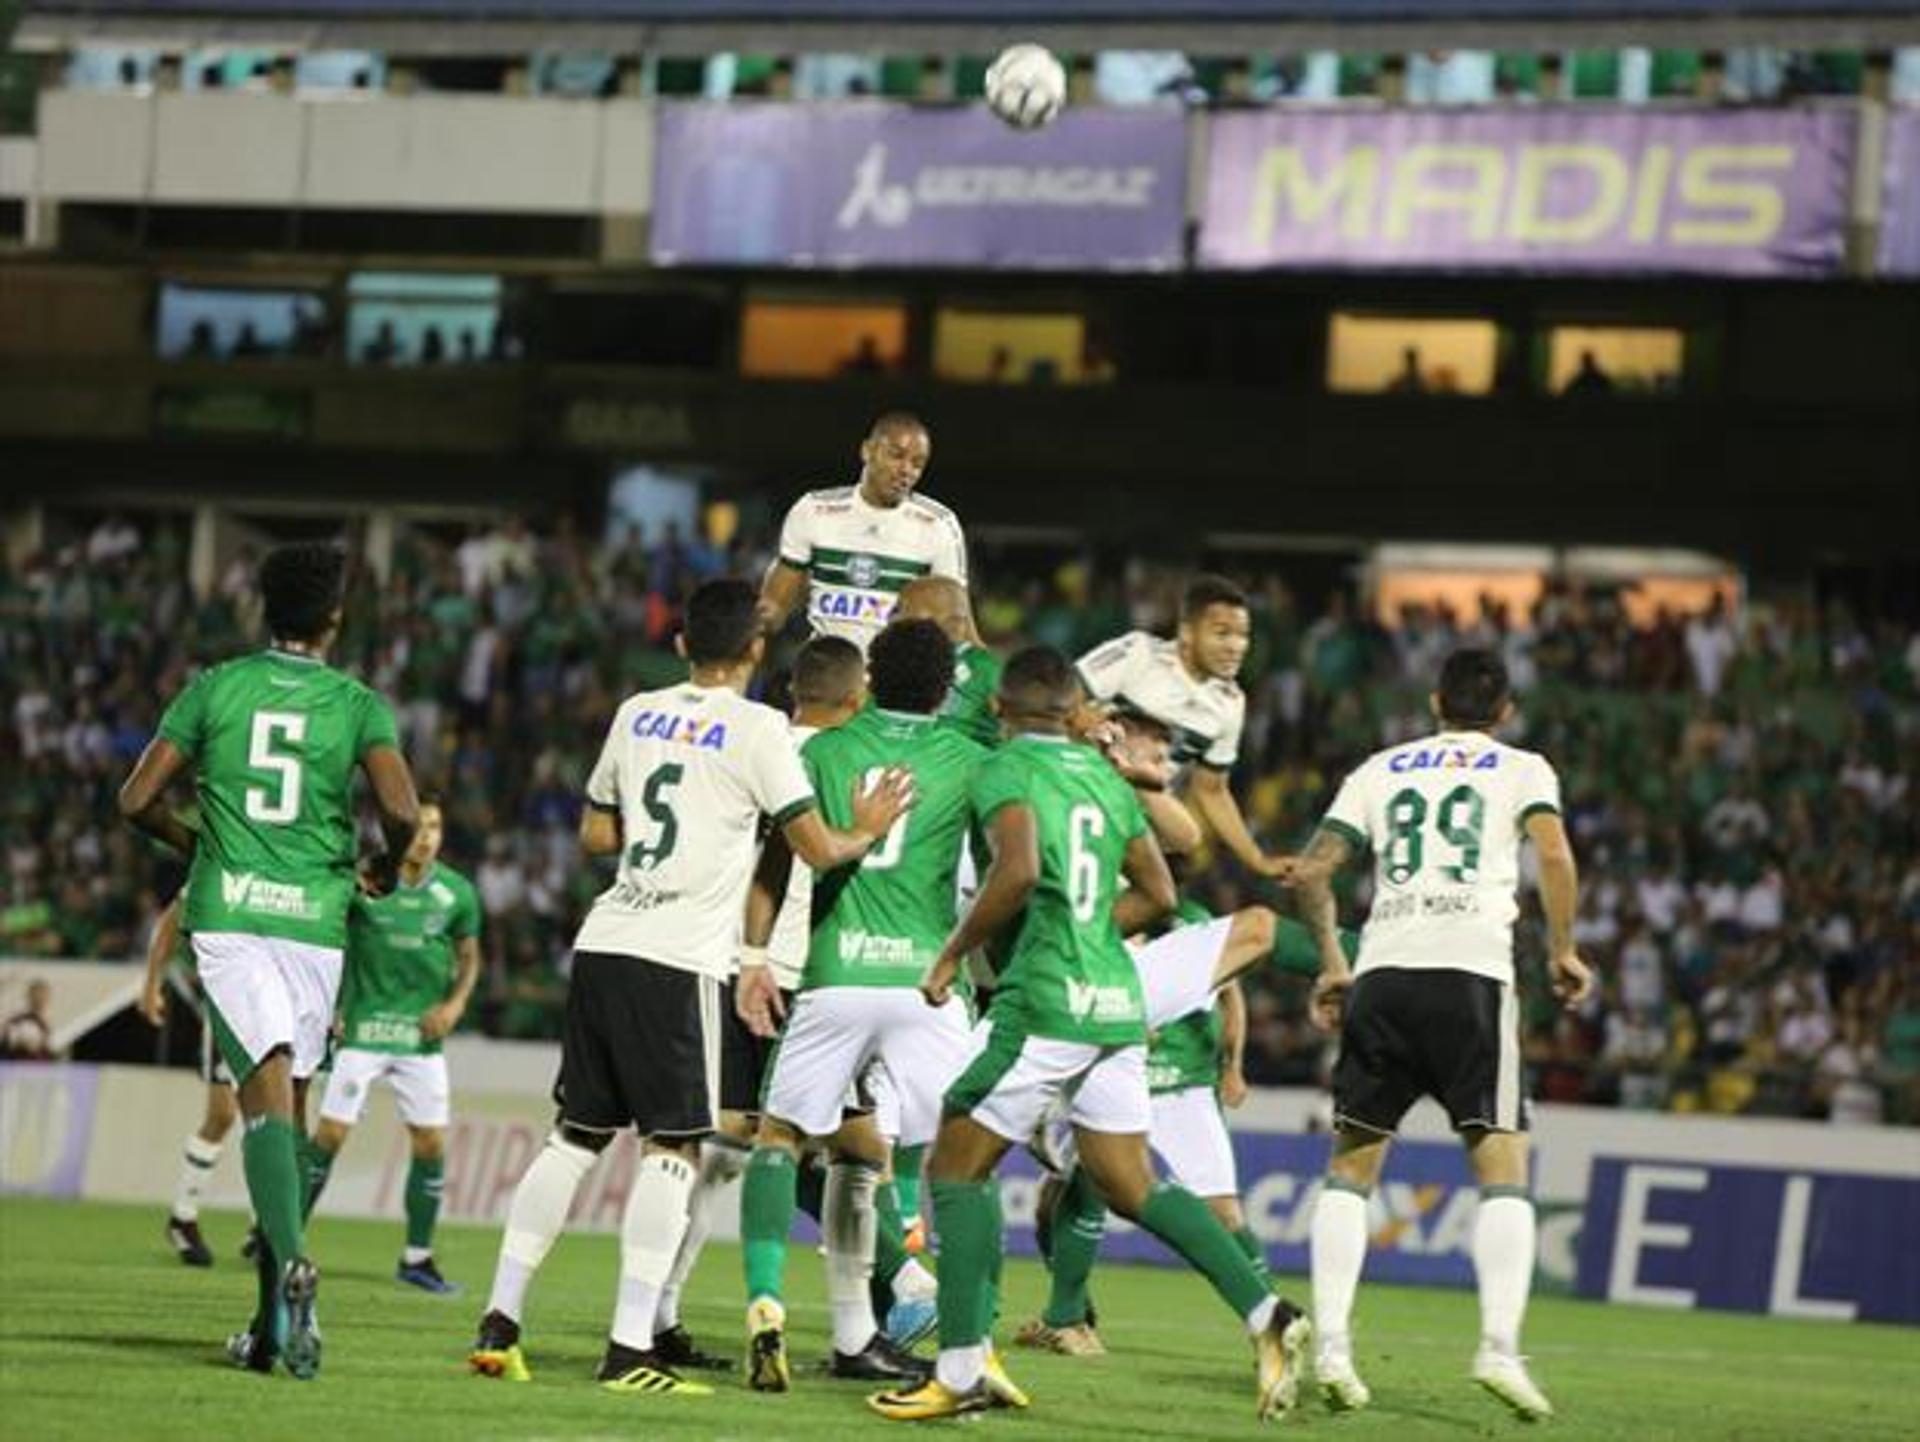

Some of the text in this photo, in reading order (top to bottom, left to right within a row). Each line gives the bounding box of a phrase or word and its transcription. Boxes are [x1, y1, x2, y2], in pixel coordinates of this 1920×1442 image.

[1248, 142, 1794, 249] MADIS
[246, 710, 306, 823] 5
[633, 711, 726, 750] CAIXA
[1389, 750, 1499, 774] CAIXA
[630, 761, 684, 873] 5
[1068, 803, 1105, 923] 6
[1384, 784, 1486, 886] 89
